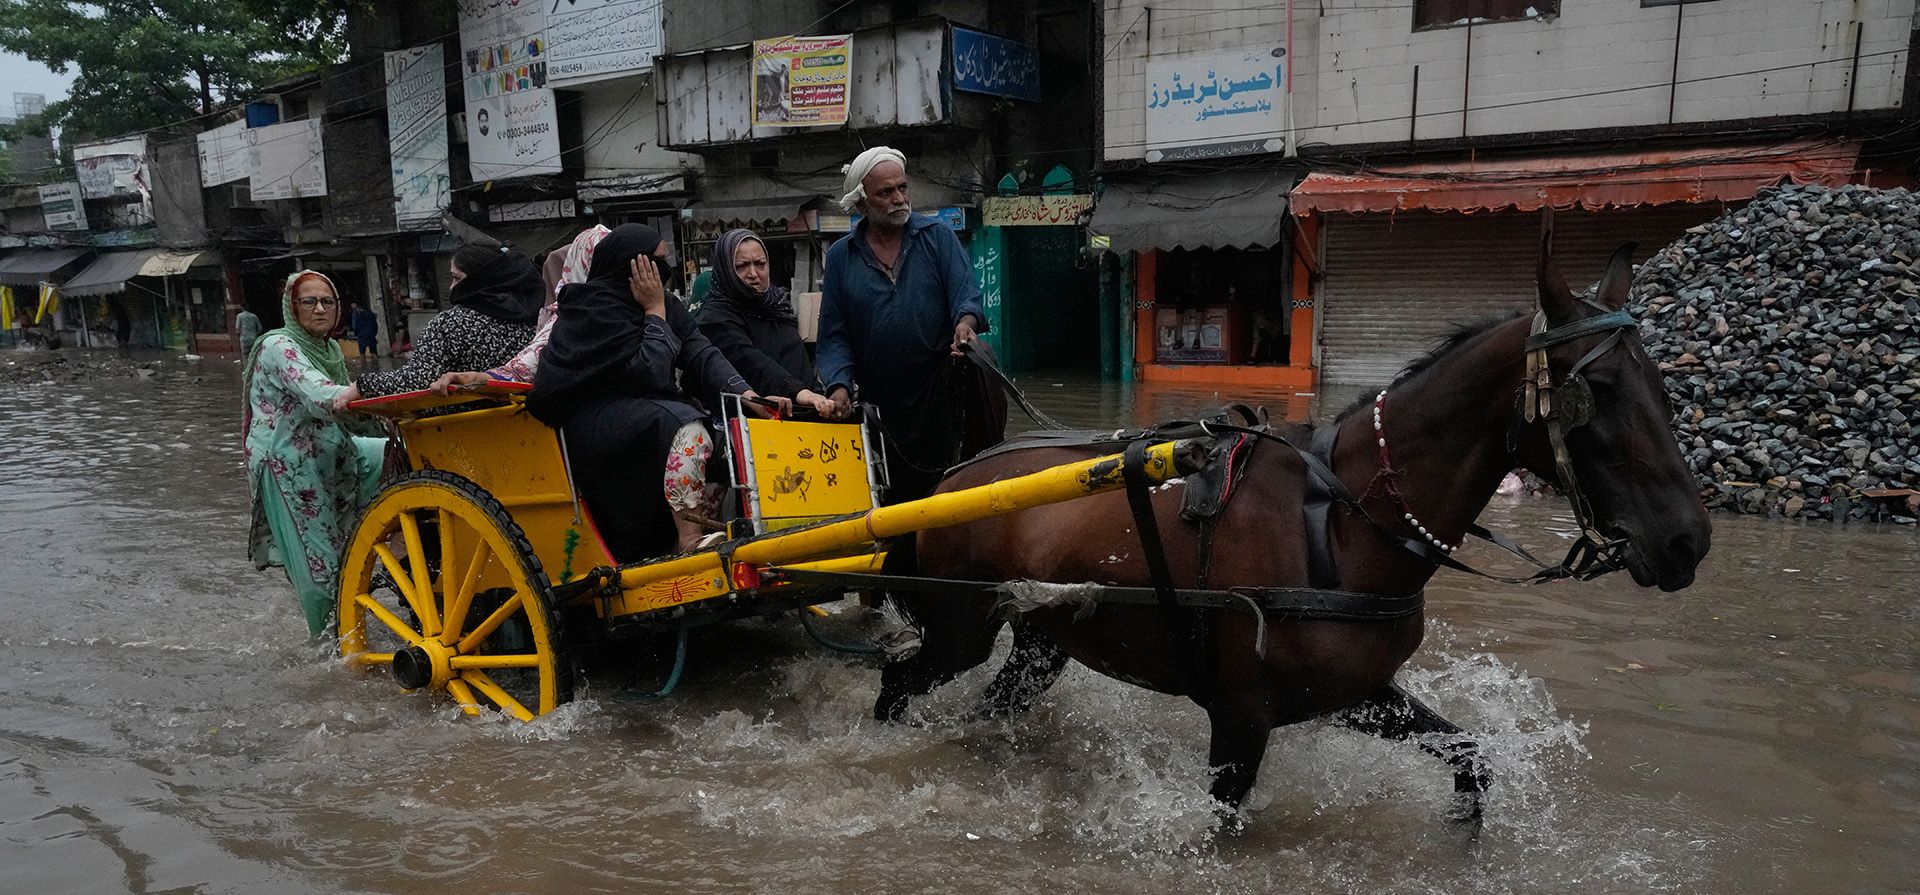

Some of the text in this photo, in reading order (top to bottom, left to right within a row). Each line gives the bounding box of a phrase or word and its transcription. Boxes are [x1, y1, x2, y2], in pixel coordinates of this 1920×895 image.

[391, 68, 433, 103] Madina
[1147, 63, 1282, 109] احسن ٹریڈرز
[391, 89, 442, 130] Packages
[1011, 206, 1032, 221] بخاری
[1031, 204, 1050, 221] شاہ
